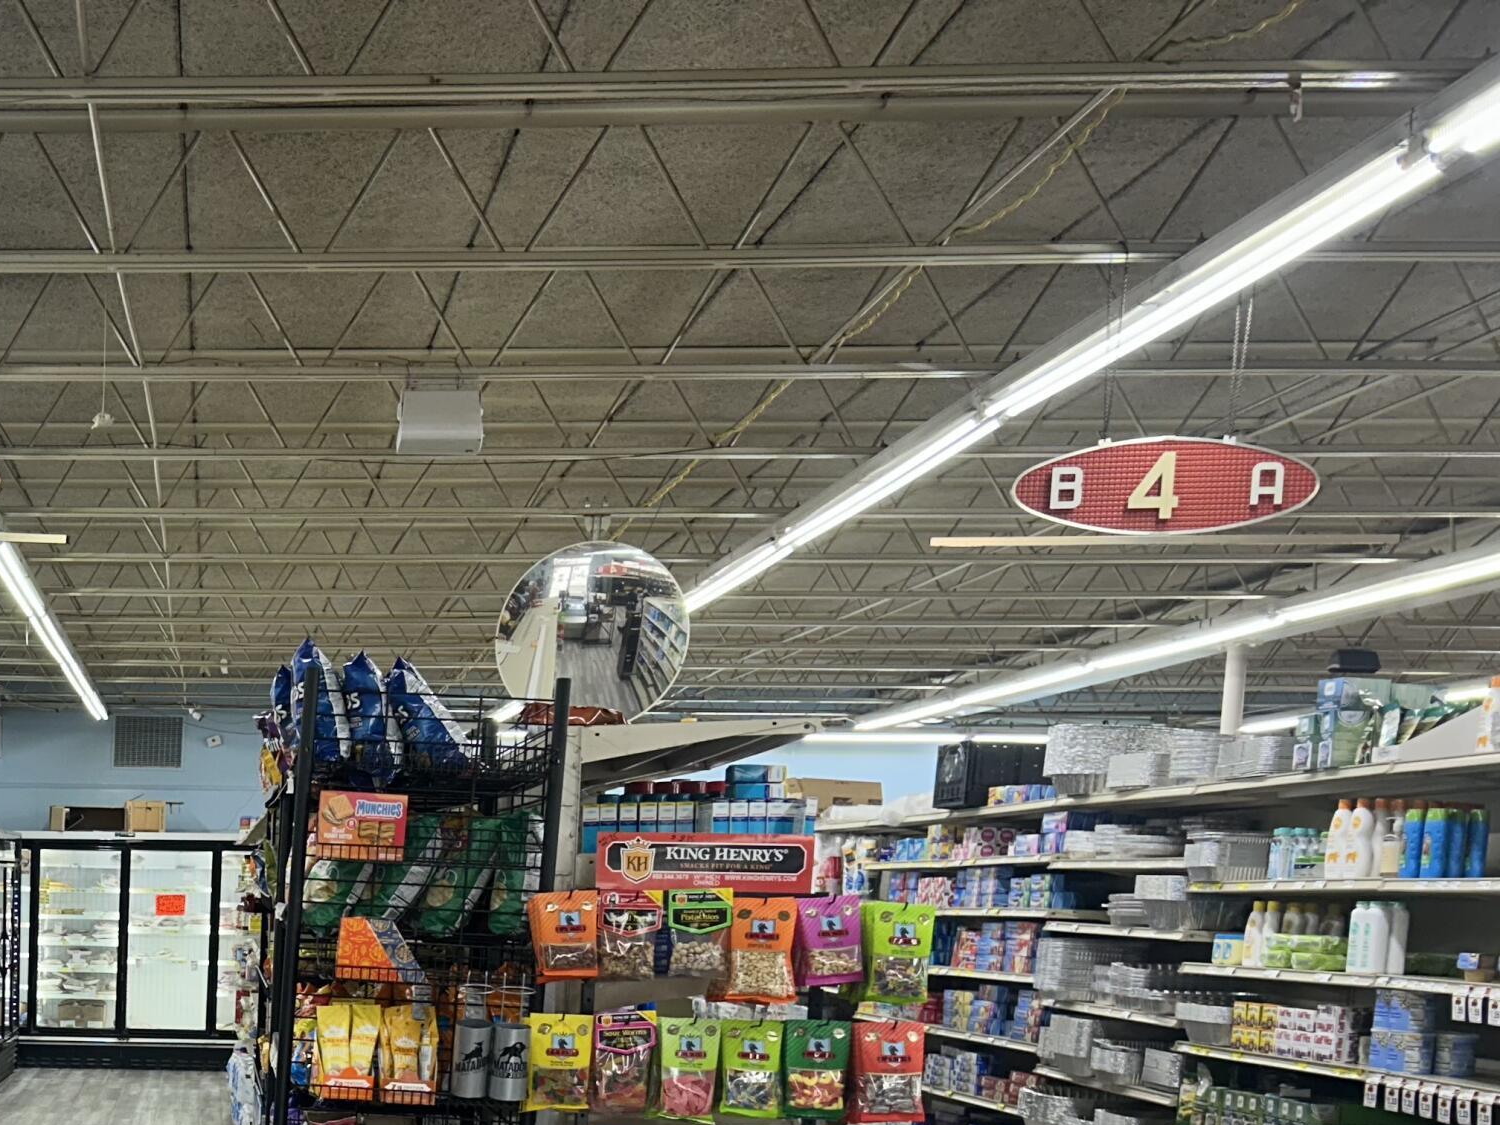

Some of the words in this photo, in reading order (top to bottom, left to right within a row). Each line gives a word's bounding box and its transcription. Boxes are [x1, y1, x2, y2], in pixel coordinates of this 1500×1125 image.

[1049, 466, 1084, 510] B
[1127, 450, 1179, 519] 4
[1249, 461, 1285, 506] A
[356, 800, 403, 818] MUNCHIES
[665, 846, 710, 861] KING
[714, 847, 785, 863] HENRY'S
[627, 855, 648, 872] KH
